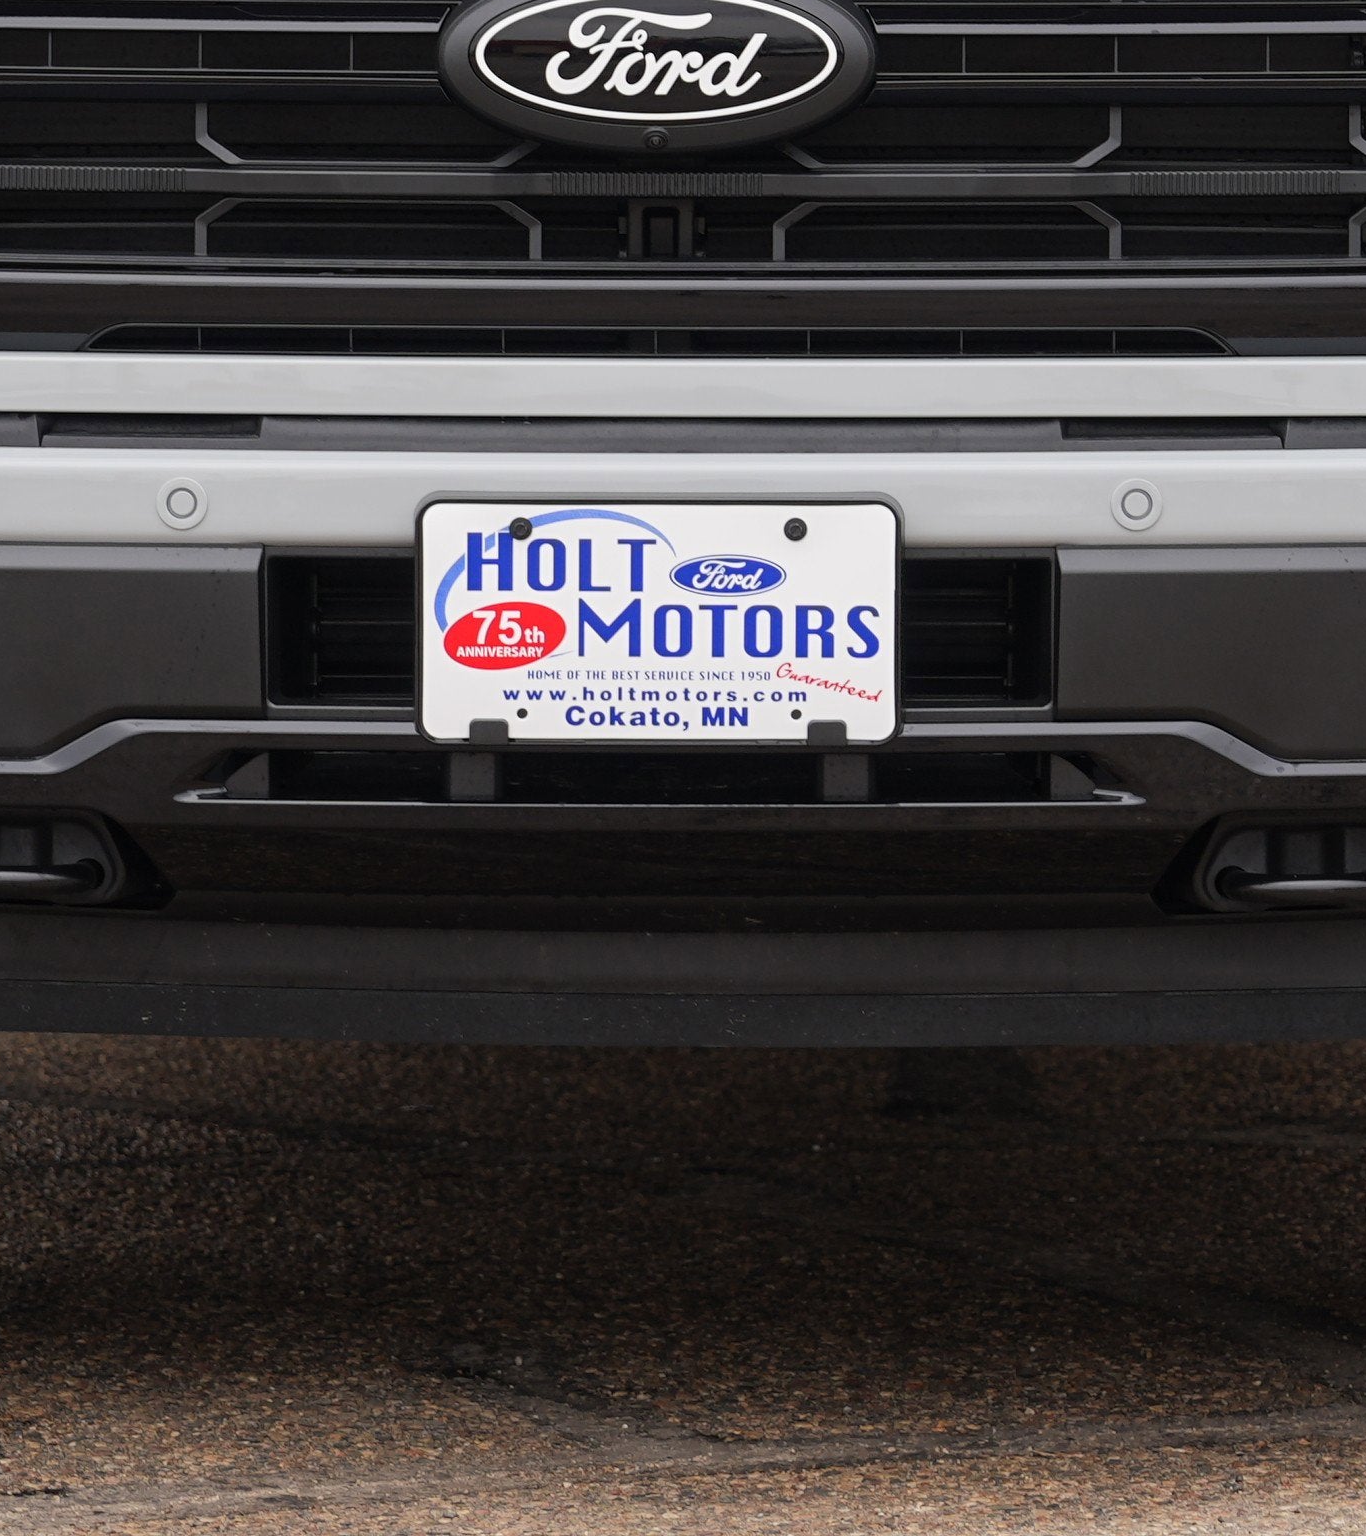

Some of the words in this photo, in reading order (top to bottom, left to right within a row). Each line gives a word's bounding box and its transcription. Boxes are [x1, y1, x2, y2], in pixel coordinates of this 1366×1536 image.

[545, 7, 768, 96] Ford
[467, 532, 657, 592] HOLT
[692, 559, 763, 590] Ford
[472, 610, 545, 645] 75th
[578, 598, 880, 659] MOTORS
[456, 646, 544, 658] ANNIVERSARY
[527, 670, 562, 680] HOME
[567, 670, 580, 680] OF
[585, 670, 607, 680] THE
[612, 670, 640, 681] BEST
[645, 670, 695, 681] SERVICE
[699, 671, 735, 681] SINCE
[741, 671, 771, 681] 1950
[776, 662, 883, 703] Guaranteed
[503, 687, 807, 702] www.holtmotors.com
[565, 705, 690, 731] Cokato,
[701, 707, 749, 726] MN
